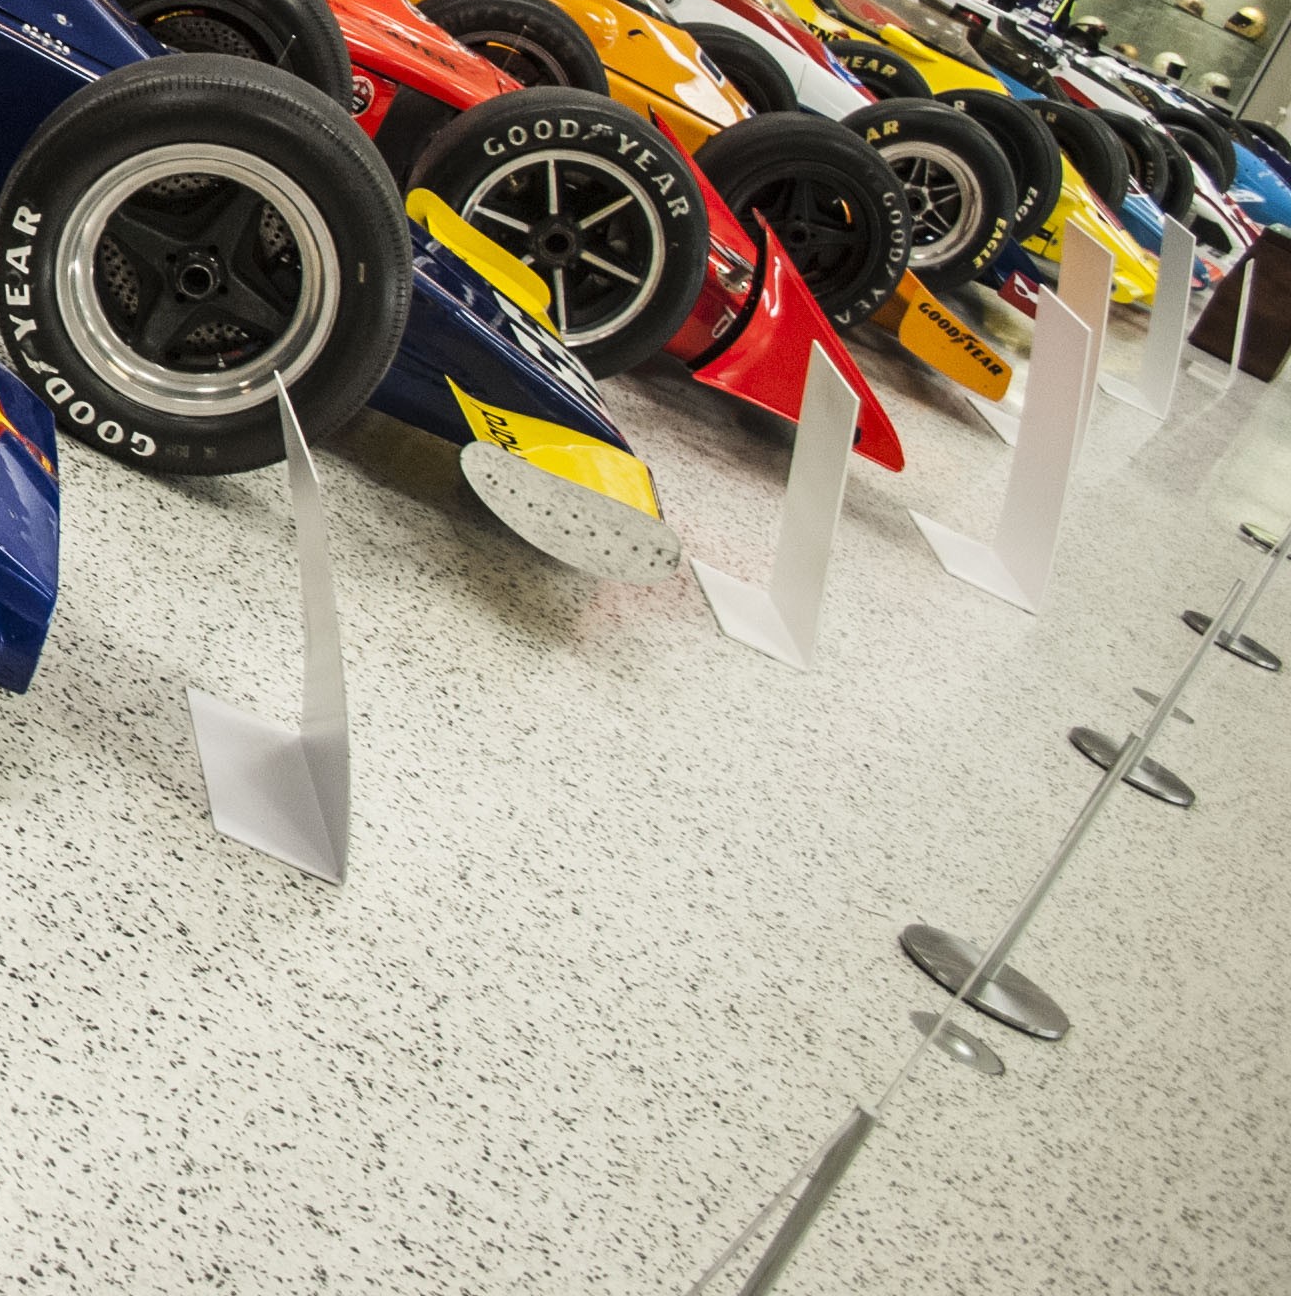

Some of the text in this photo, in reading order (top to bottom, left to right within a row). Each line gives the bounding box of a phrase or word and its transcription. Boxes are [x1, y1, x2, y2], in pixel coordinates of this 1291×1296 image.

[482, 117, 692, 220] GOODYEAR
[971, 217, 1008, 269] EAGLE
[11, 203, 157, 458] GOODYEAR
[917, 300, 1005, 380] GOODYEAR
